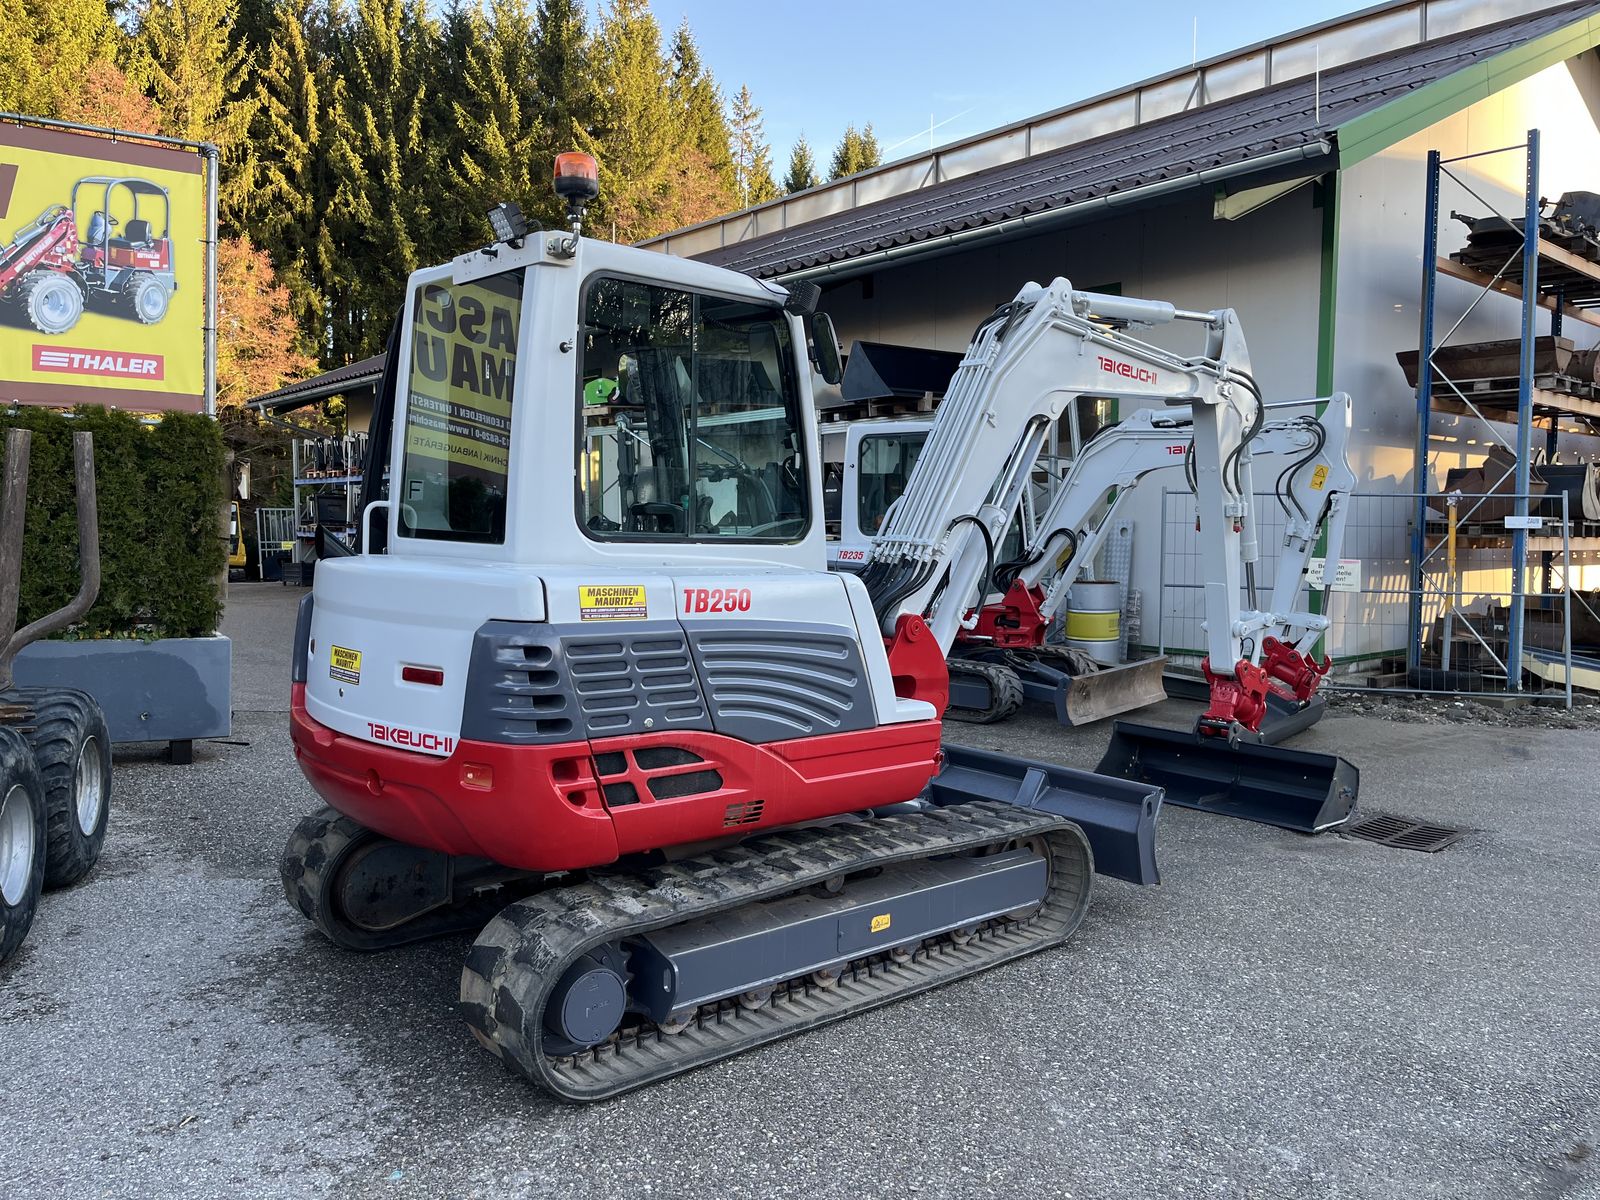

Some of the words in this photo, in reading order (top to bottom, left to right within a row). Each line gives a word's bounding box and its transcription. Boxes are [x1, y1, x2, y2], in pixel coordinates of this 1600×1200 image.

[1097, 356, 1158, 385] TAKEUCHI
[838, 550, 864, 560] TB235
[587, 587, 639, 597] MASCHINEN
[683, 588, 752, 614] TB250
[594, 597, 634, 606] MAURITZ
[367, 722, 453, 753] TAKEUCHI
